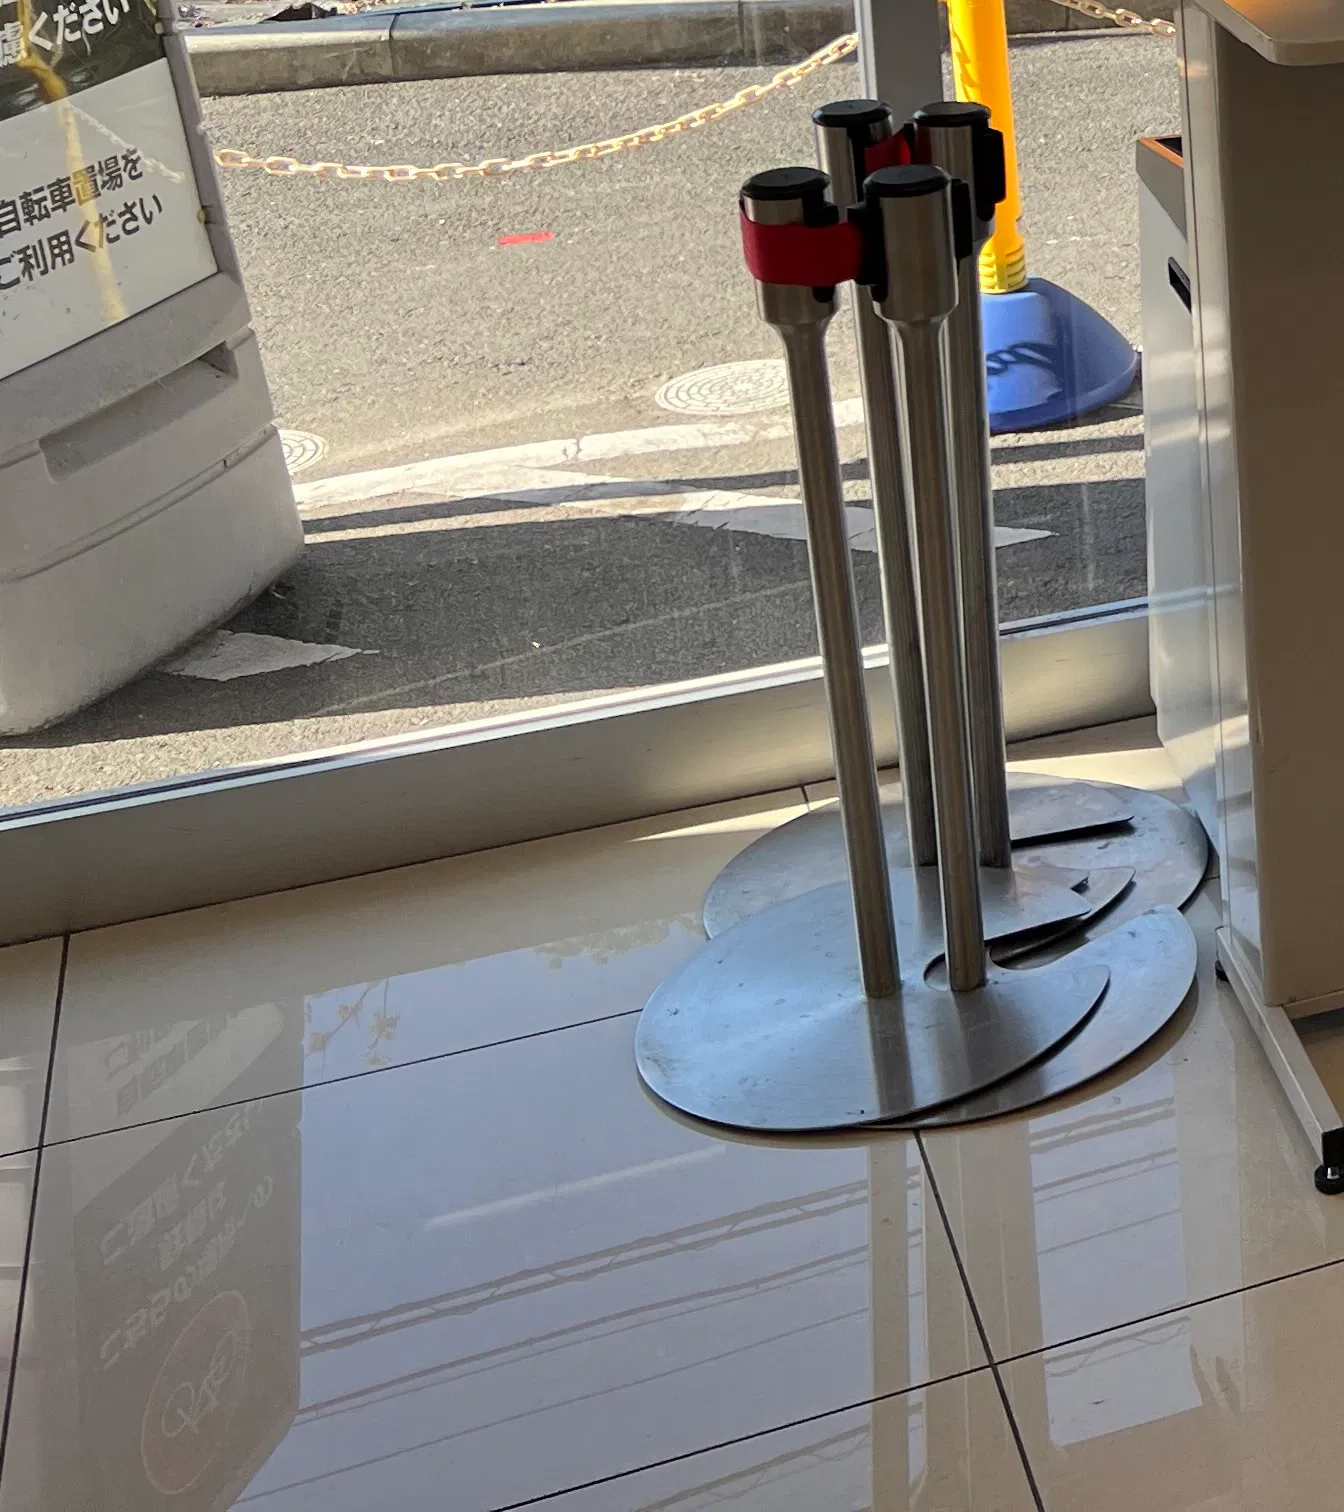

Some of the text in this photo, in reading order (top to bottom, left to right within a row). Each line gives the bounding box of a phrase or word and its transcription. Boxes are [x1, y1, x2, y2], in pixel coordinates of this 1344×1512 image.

[0, 148, 144, 239] 自転車置場を
[0, 194, 163, 291] ご利用ください
